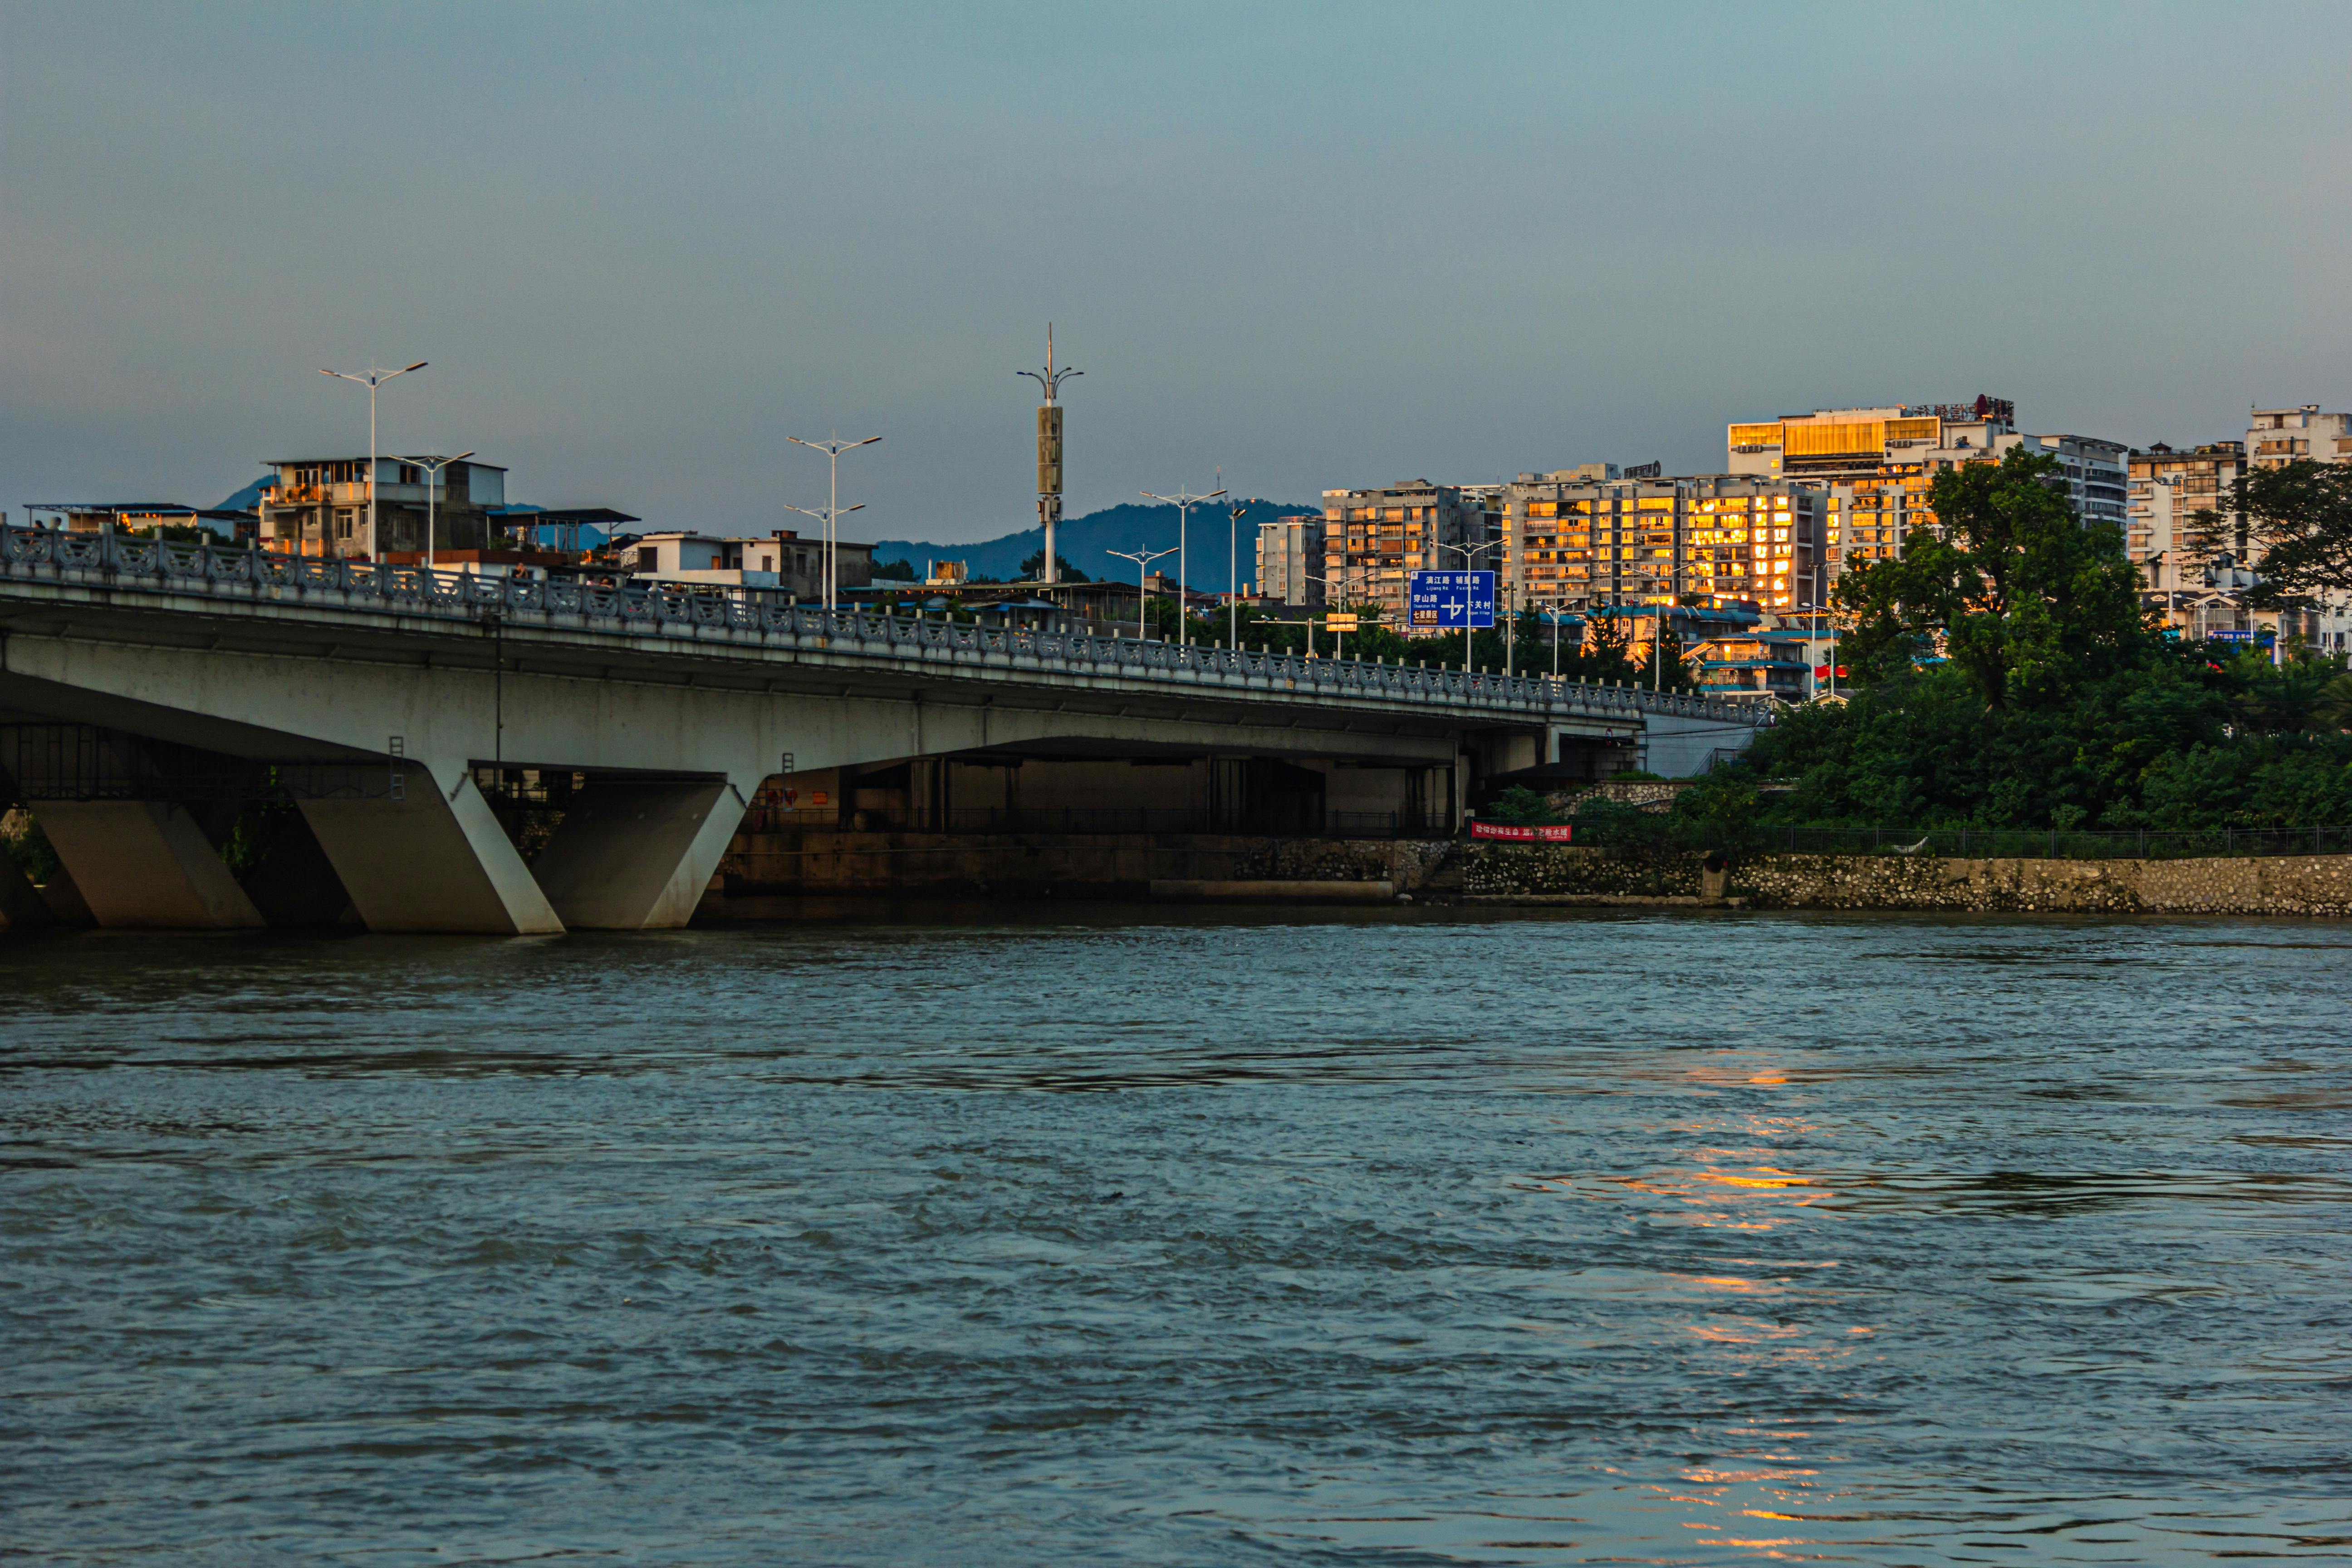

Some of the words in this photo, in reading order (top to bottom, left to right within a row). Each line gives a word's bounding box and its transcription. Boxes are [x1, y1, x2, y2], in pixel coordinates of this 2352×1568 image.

[1426, 576, 1450, 584] 漓江路
[1413, 594, 1437, 603] 穿山路
[1413, 610, 1437, 618] 七星景区
[1523, 828, 1567, 836] 远危险水域
